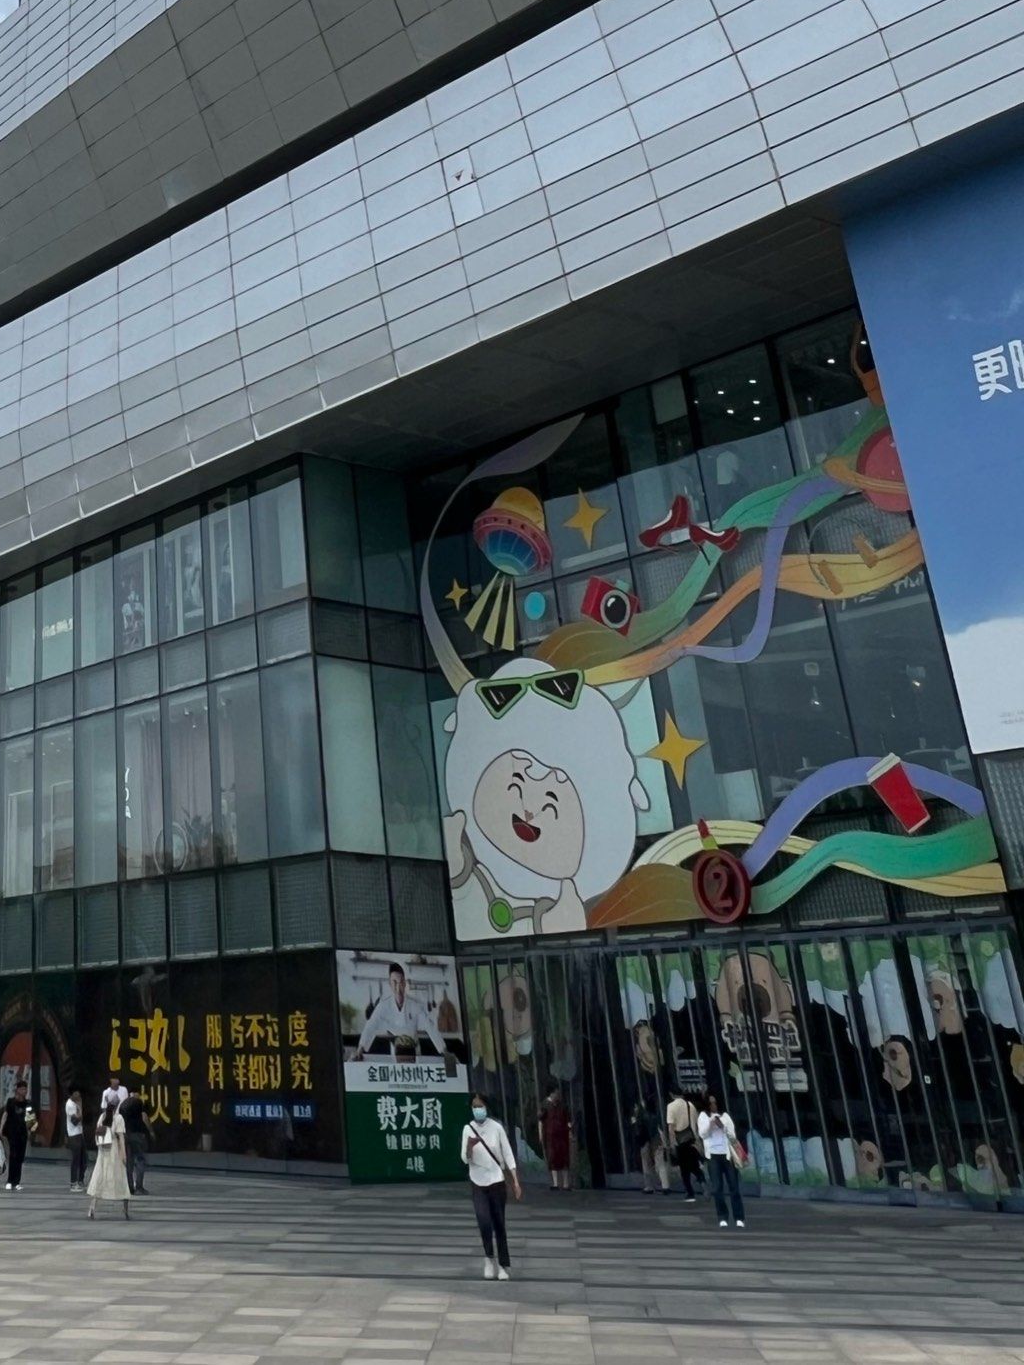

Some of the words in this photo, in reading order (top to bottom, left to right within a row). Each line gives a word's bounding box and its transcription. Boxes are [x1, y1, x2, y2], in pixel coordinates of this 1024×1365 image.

[710, 867, 733, 908] 2
[367, 1065, 447, 1084] 全国小炒肉大王
[376, 1094, 444, 1131] 费大厨
